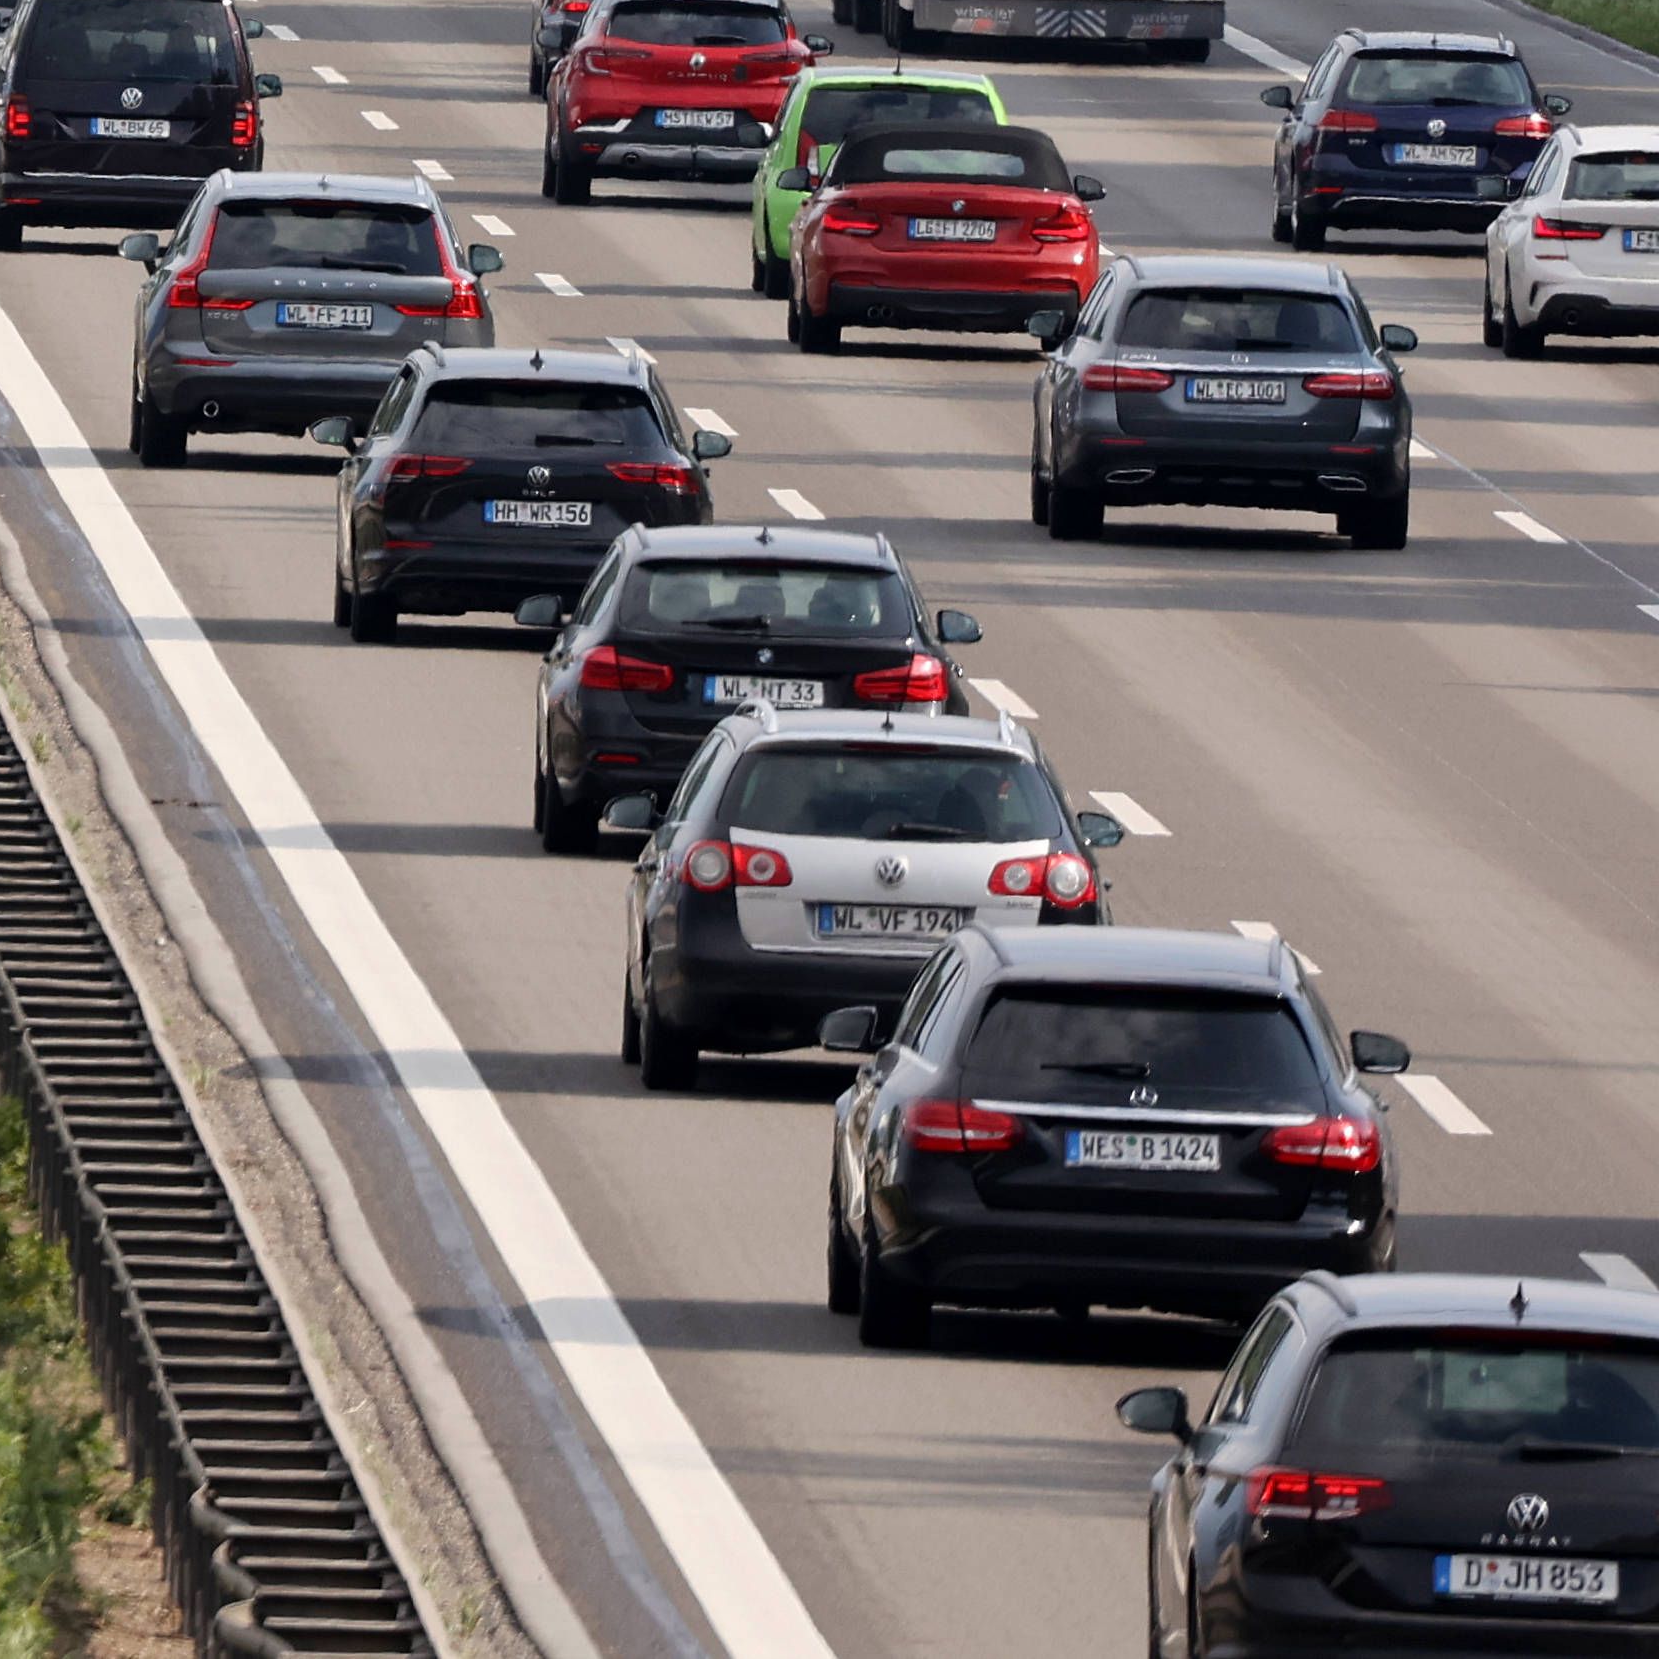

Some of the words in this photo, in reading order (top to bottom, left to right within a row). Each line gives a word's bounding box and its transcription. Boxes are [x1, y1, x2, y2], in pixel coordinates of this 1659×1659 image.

[954, 6, 1015, 21] winkler
[103, 120, 120, 134] WL
[127, 121, 147, 134] BW
[148, 122, 164, 135] 65
[286, 306, 307, 322] WL
[316, 307, 338, 322] FF
[341, 308, 370, 324] 111
[1196, 381, 1214, 398] WL
[1248, 382, 1284, 400] 1001
[494, 502, 518, 521] HH
[530, 504, 552, 522] WR
[555, 504, 589, 524] 156
[723, 679, 748, 698] WL
[761, 681, 786, 700] NT
[791, 682, 815, 702] 33
[834, 907, 862, 930] WL
[878, 908, 908, 932] VF
[912, 910, 954, 933] 194
[1082, 1135, 1124, 1160] WES
[1141, 1138, 1156, 1161] B
[1160, 1137, 1215, 1163] 1424
[1465, 1559, 1482, 1588] D
[1503, 1560, 1543, 1591] JH
[1549, 1561, 1606, 1593] 853
